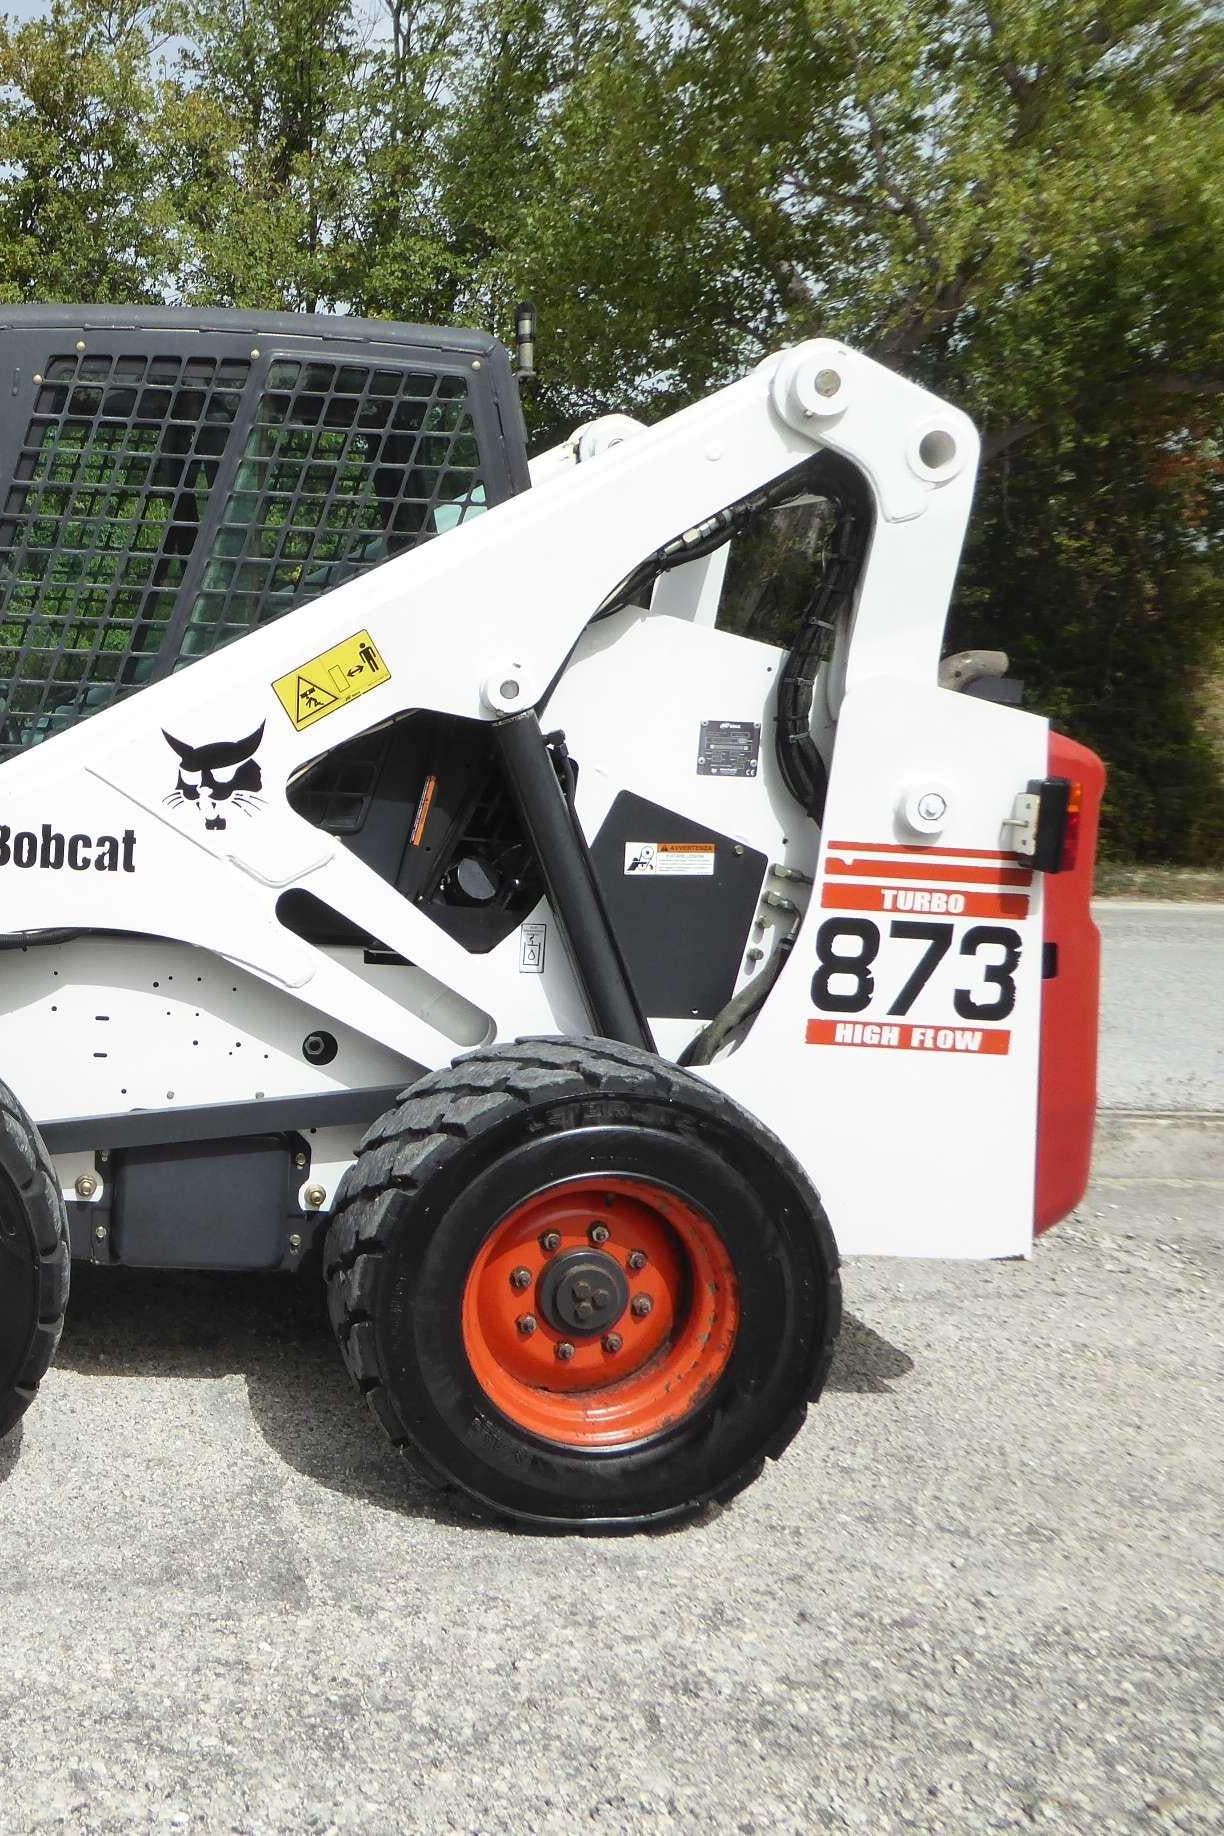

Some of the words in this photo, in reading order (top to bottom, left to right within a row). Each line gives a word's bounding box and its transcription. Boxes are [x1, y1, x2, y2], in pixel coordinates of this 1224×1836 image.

[881, 888, 965, 914] TURBO
[810, 916, 1023, 1022] 873
[834, 1023, 900, 1047] HIGH
[911, 1028, 983, 1051] FLOW
